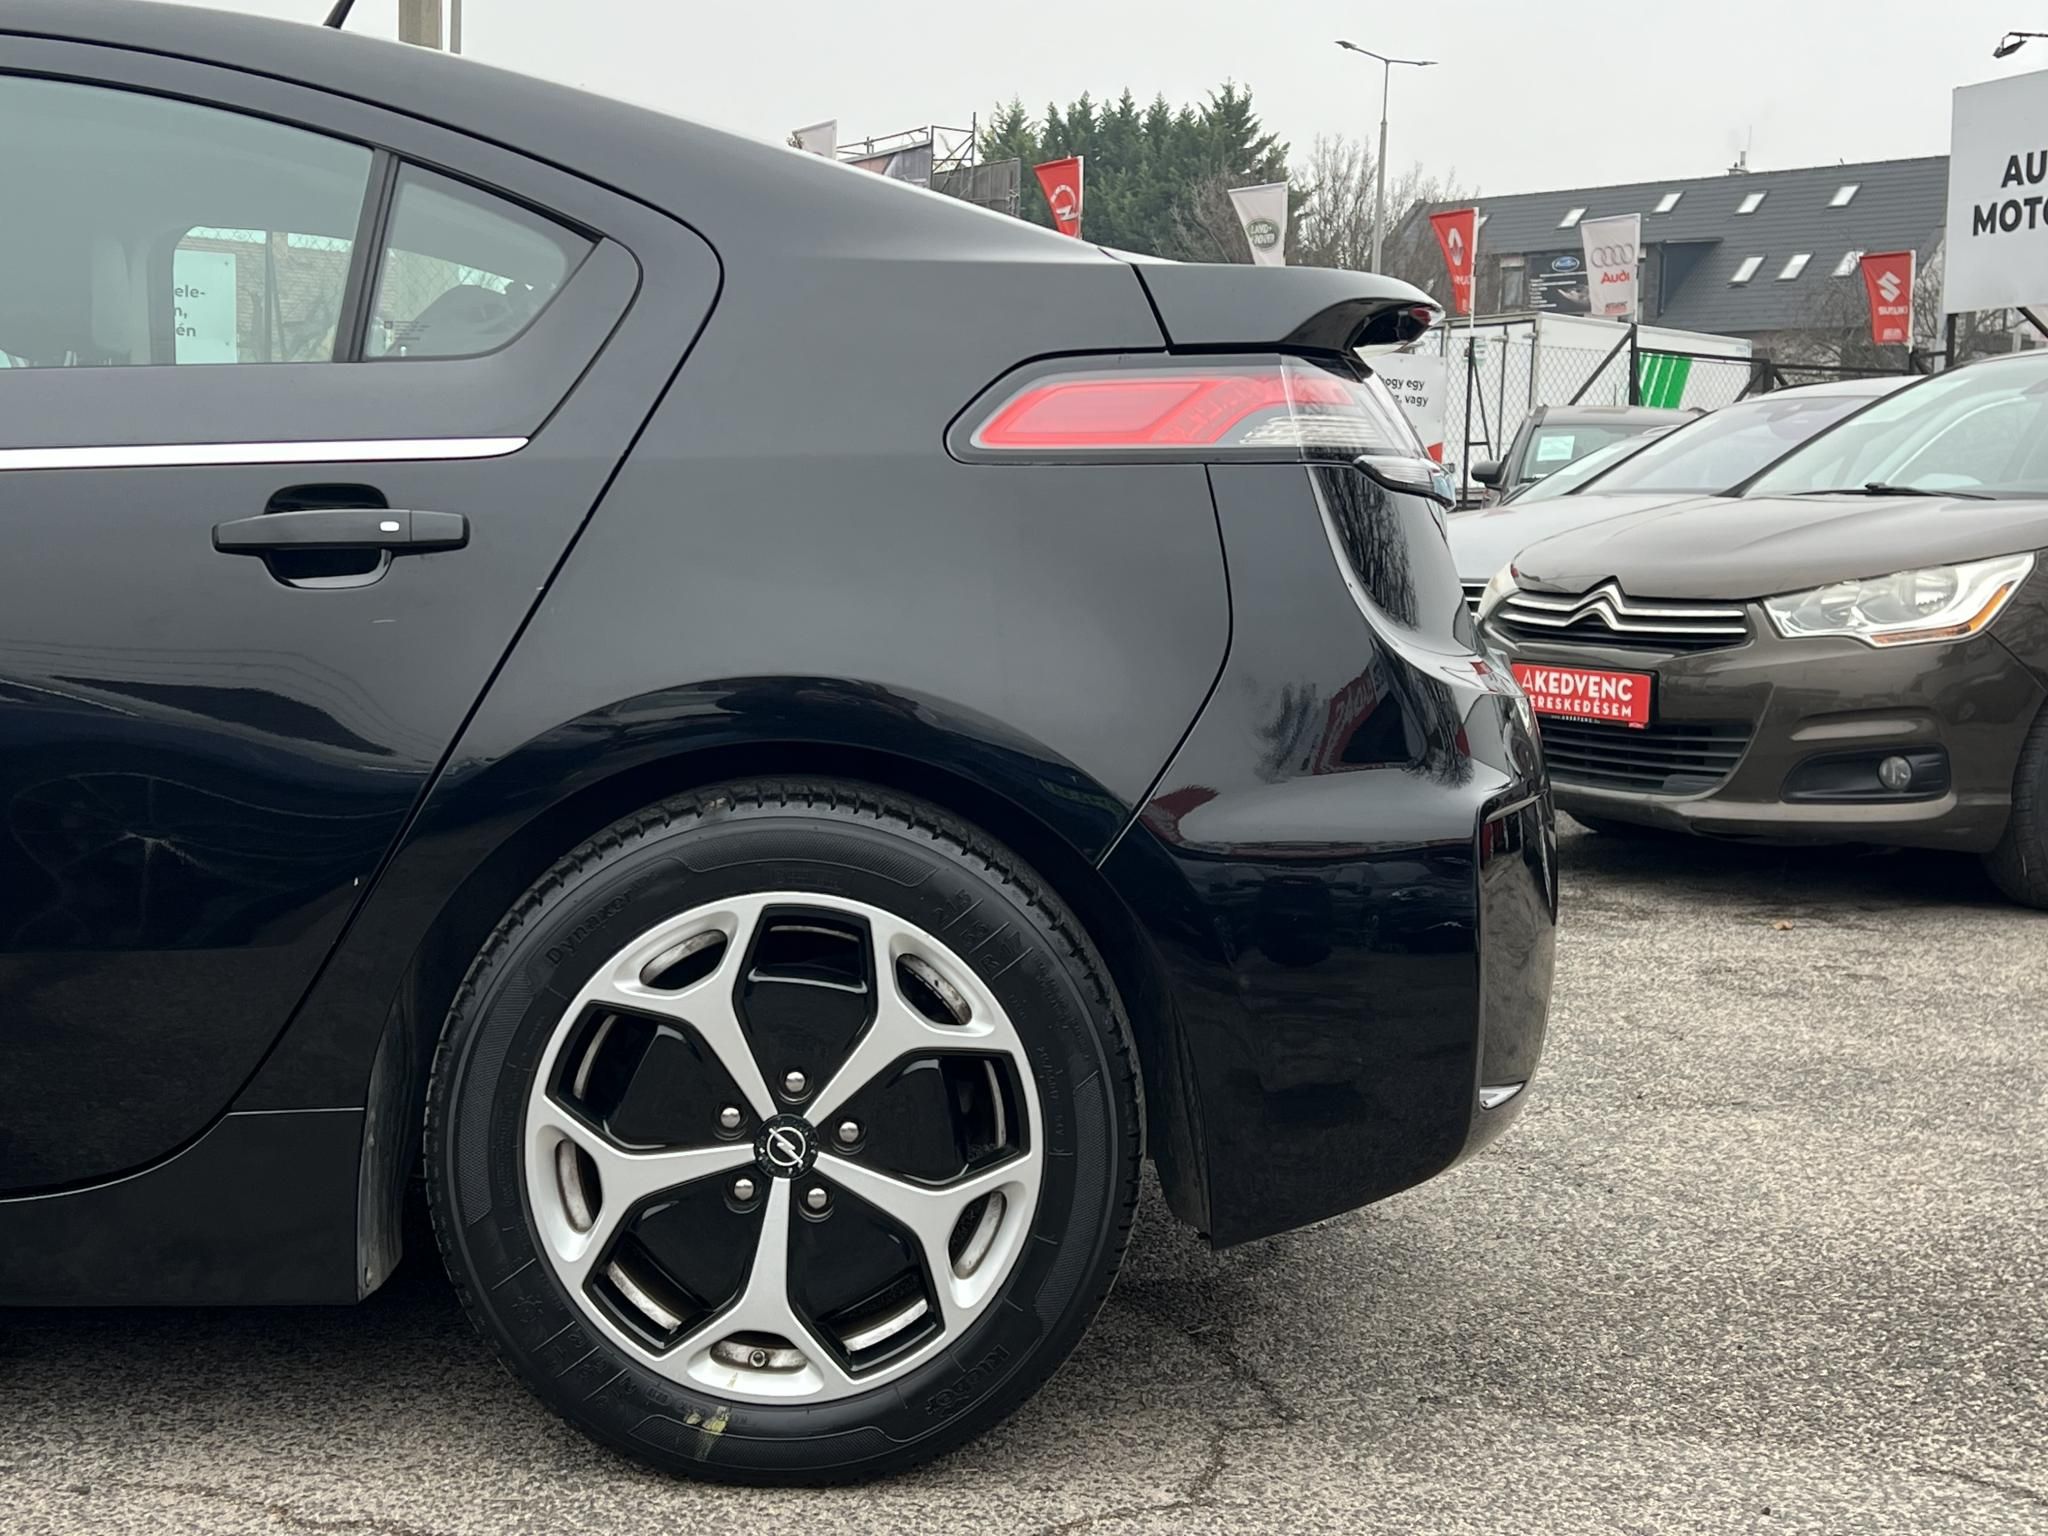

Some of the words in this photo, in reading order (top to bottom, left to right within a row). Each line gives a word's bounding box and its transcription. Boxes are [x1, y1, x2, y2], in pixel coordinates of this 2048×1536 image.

[1972, 196, 2048, 236] MOT
[1250, 223, 1268, 234] LAND
[1600, 269, 1631, 285] Audi
[1406, 379, 1426, 391] egy
[1404, 394, 1429, 408] vagy
[1530, 694, 1632, 718] ERESKEDÉSEM
